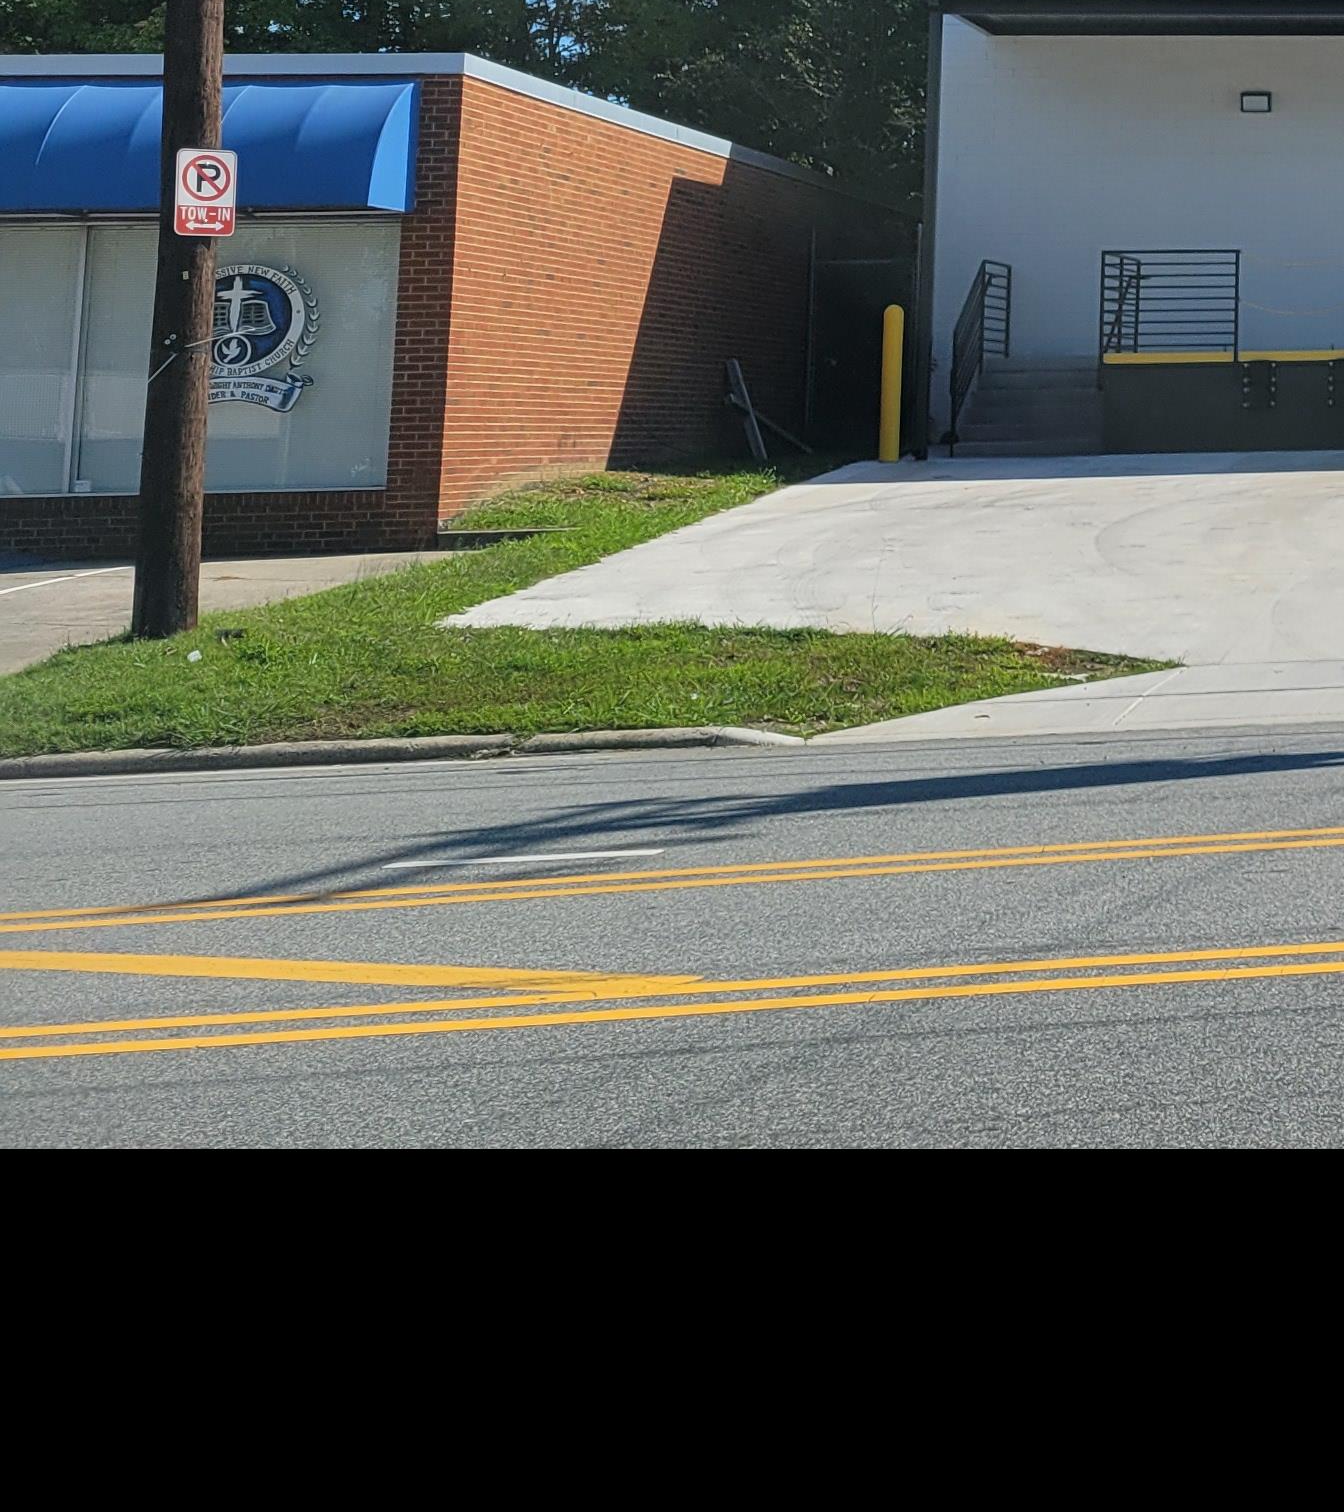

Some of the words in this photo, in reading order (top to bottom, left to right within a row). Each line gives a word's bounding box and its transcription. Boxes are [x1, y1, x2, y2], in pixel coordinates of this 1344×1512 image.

[180, 206, 231, 221] TOW-IN
[248, 265, 270, 277] NEW
[272, 273, 297, 295] FAITH
[227, 365, 262, 376] BAPTIST
[264, 339, 296, 366] CHURCH
[241, 390, 270, 404] PASTOR
